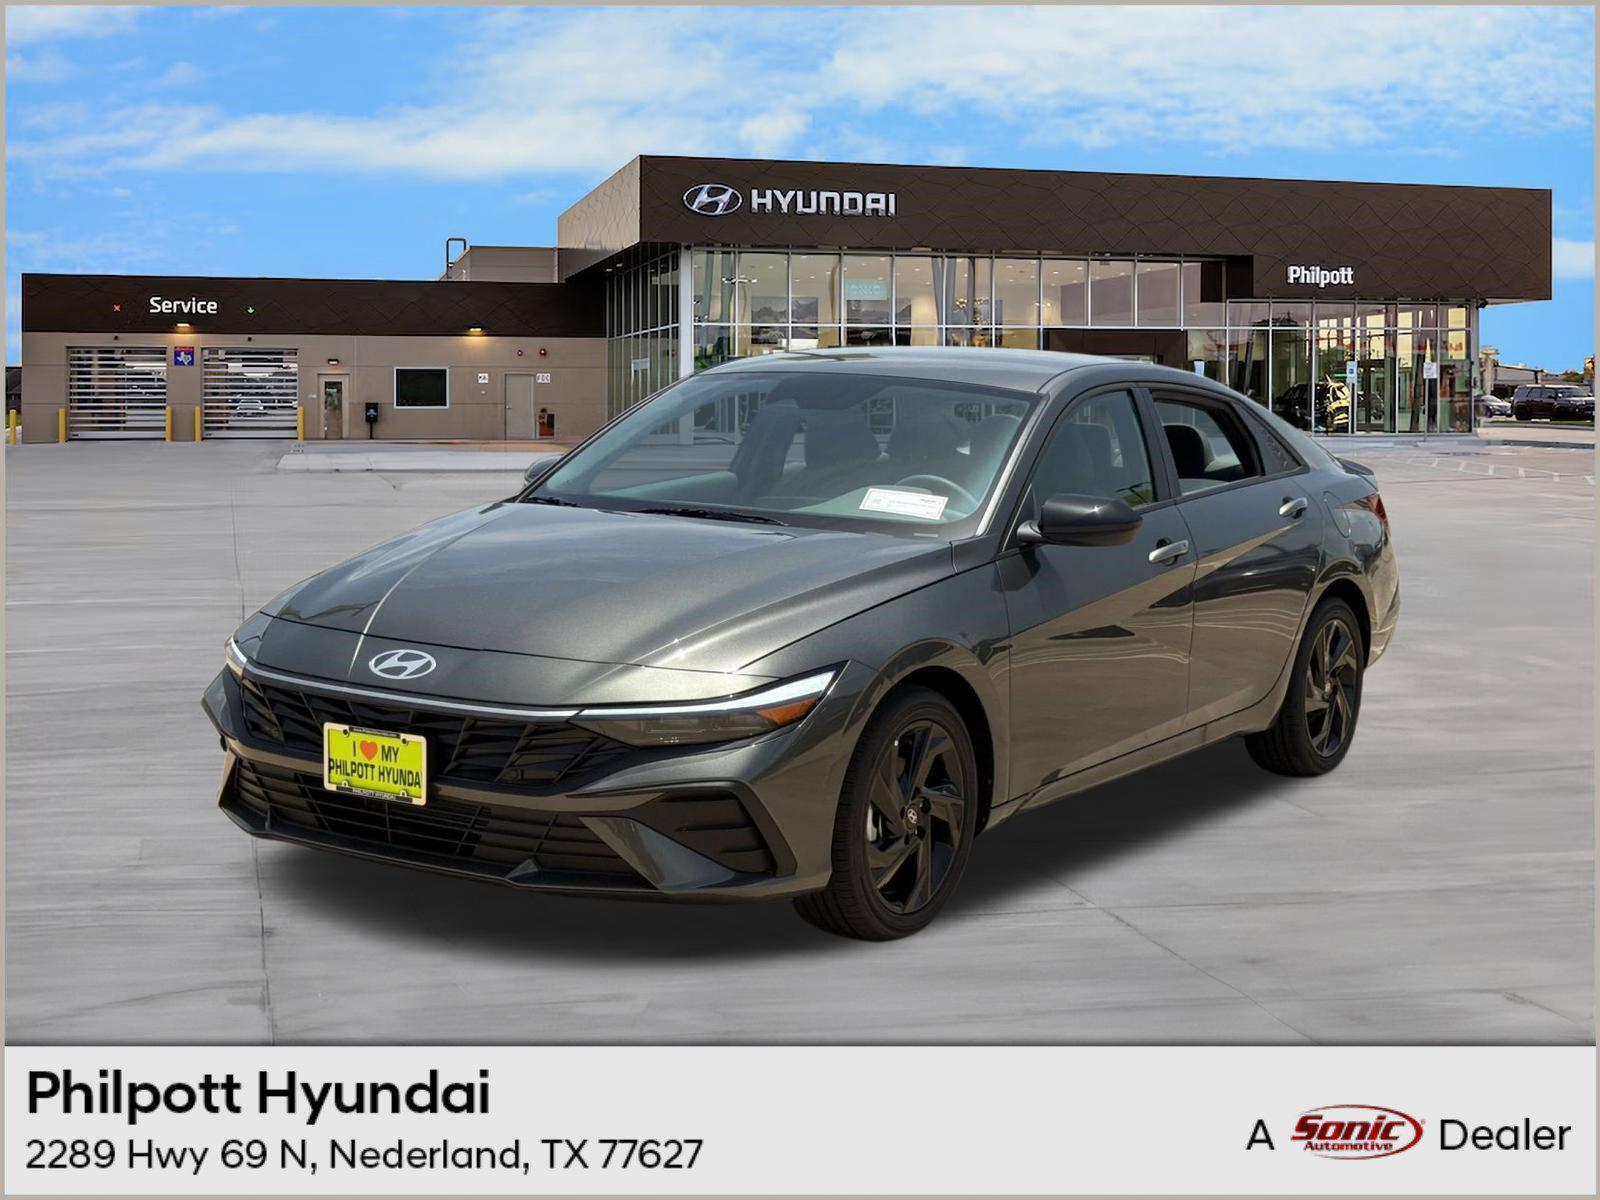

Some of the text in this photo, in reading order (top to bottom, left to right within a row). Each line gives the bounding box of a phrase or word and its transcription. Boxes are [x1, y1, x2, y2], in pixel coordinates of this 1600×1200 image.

[751, 189, 896, 216] HYUNDAI
[1287, 265, 1354, 288] Philpott
[149, 296, 218, 314] Service
[352, 741, 400, 763] I MY
[329, 758, 423, 789] PHILPOTT HYUNDA
